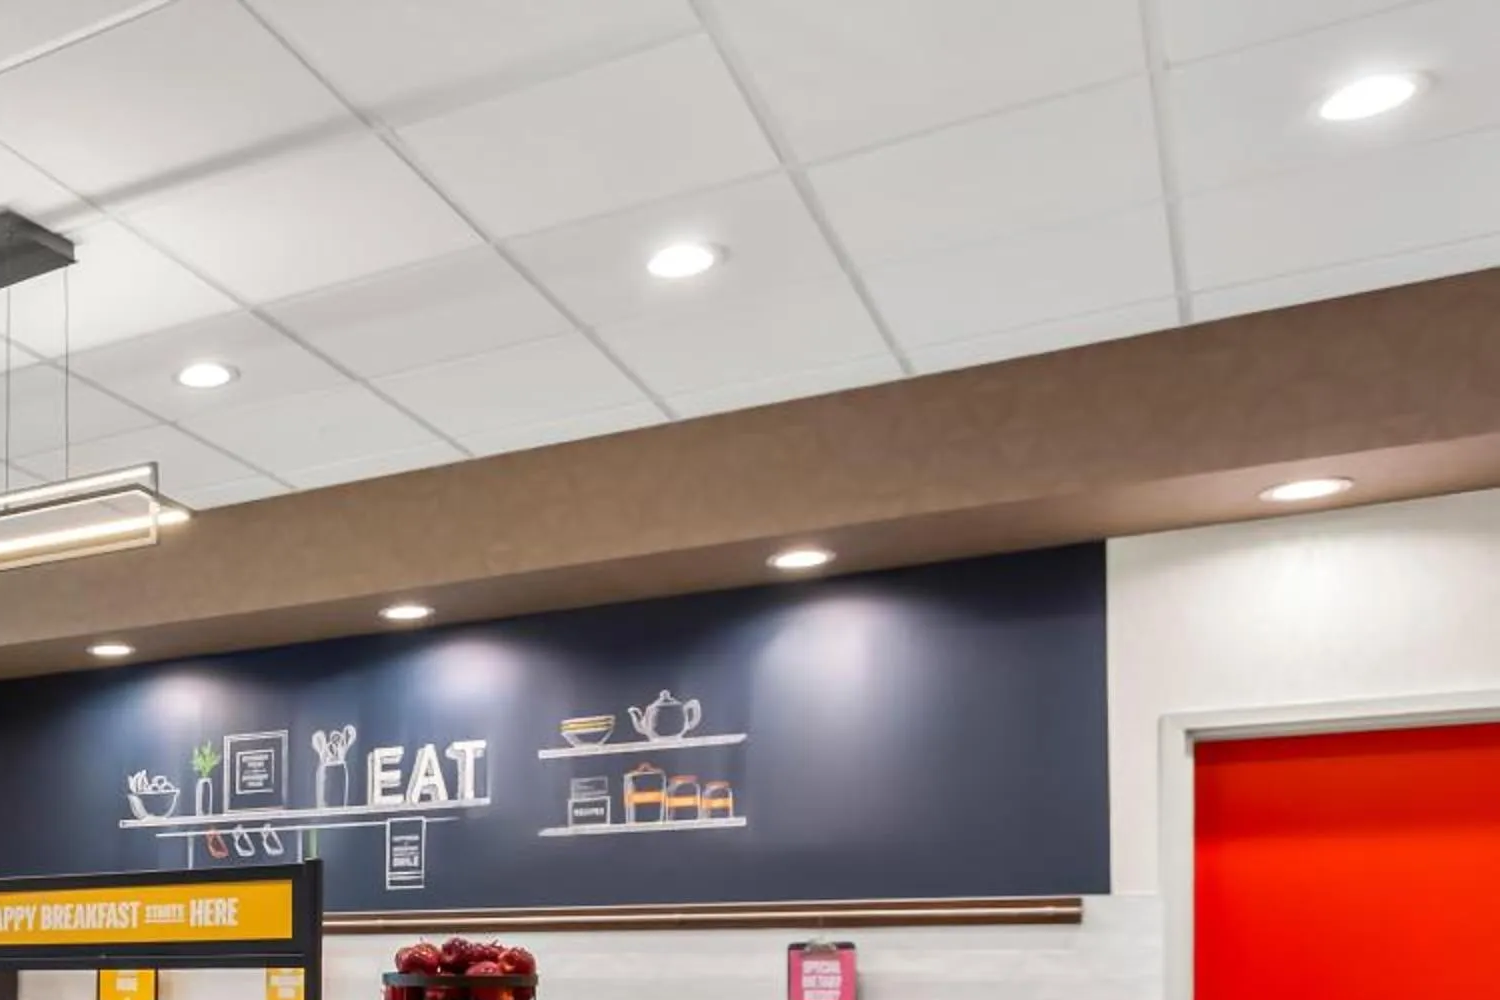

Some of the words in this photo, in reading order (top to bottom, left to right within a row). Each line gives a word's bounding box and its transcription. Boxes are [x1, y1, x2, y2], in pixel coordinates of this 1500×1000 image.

[368, 740, 486, 805] EAT
[41, 901, 141, 930] BREAKFAST
[189, 897, 239, 928] HERE
